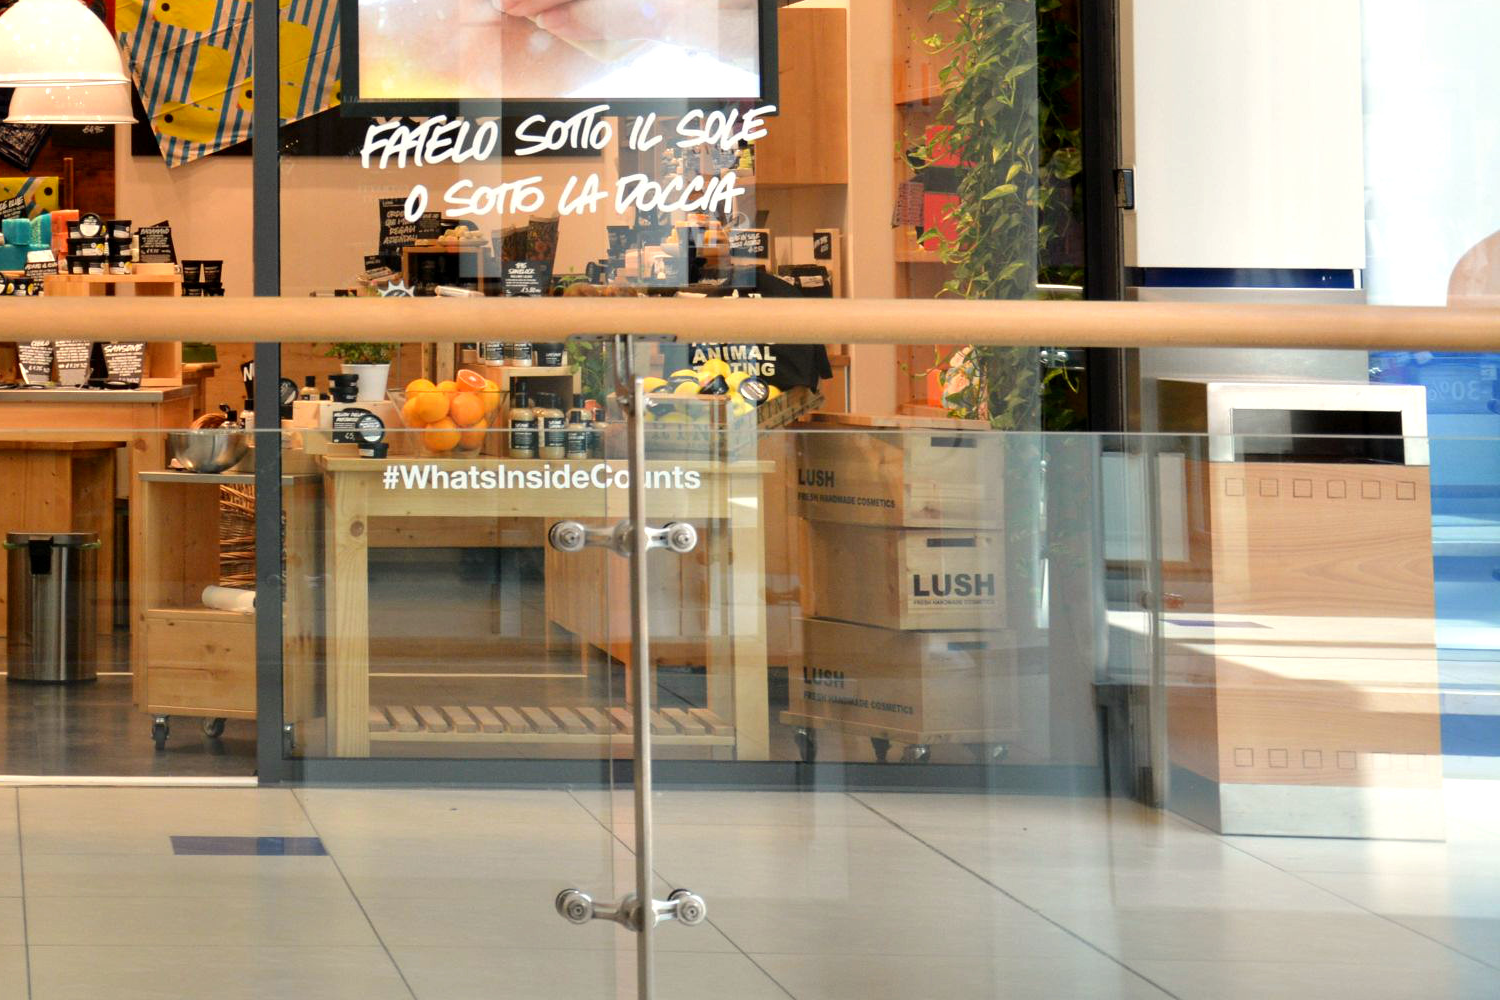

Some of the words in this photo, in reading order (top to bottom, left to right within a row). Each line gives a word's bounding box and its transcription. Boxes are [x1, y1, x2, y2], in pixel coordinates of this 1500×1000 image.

[360, 115, 499, 169] FATELO
[514, 105, 614, 156] SOTTO
[629, 111, 665, 152] IL
[676, 105, 778, 145] SOLE
[404, 184, 429, 223] O
[444, 176, 545, 217] SOTTO
[558, 173, 610, 215] LA
[615, 171, 746, 214] DOCCIA
[692, 345, 777, 364] ANIMAL
[382, 463, 701, 490] #WhatsInsideConts
[798, 468, 835, 488] LUSH
[913, 573, 996, 597] LUSH
[803, 666, 845, 689] LUSH
